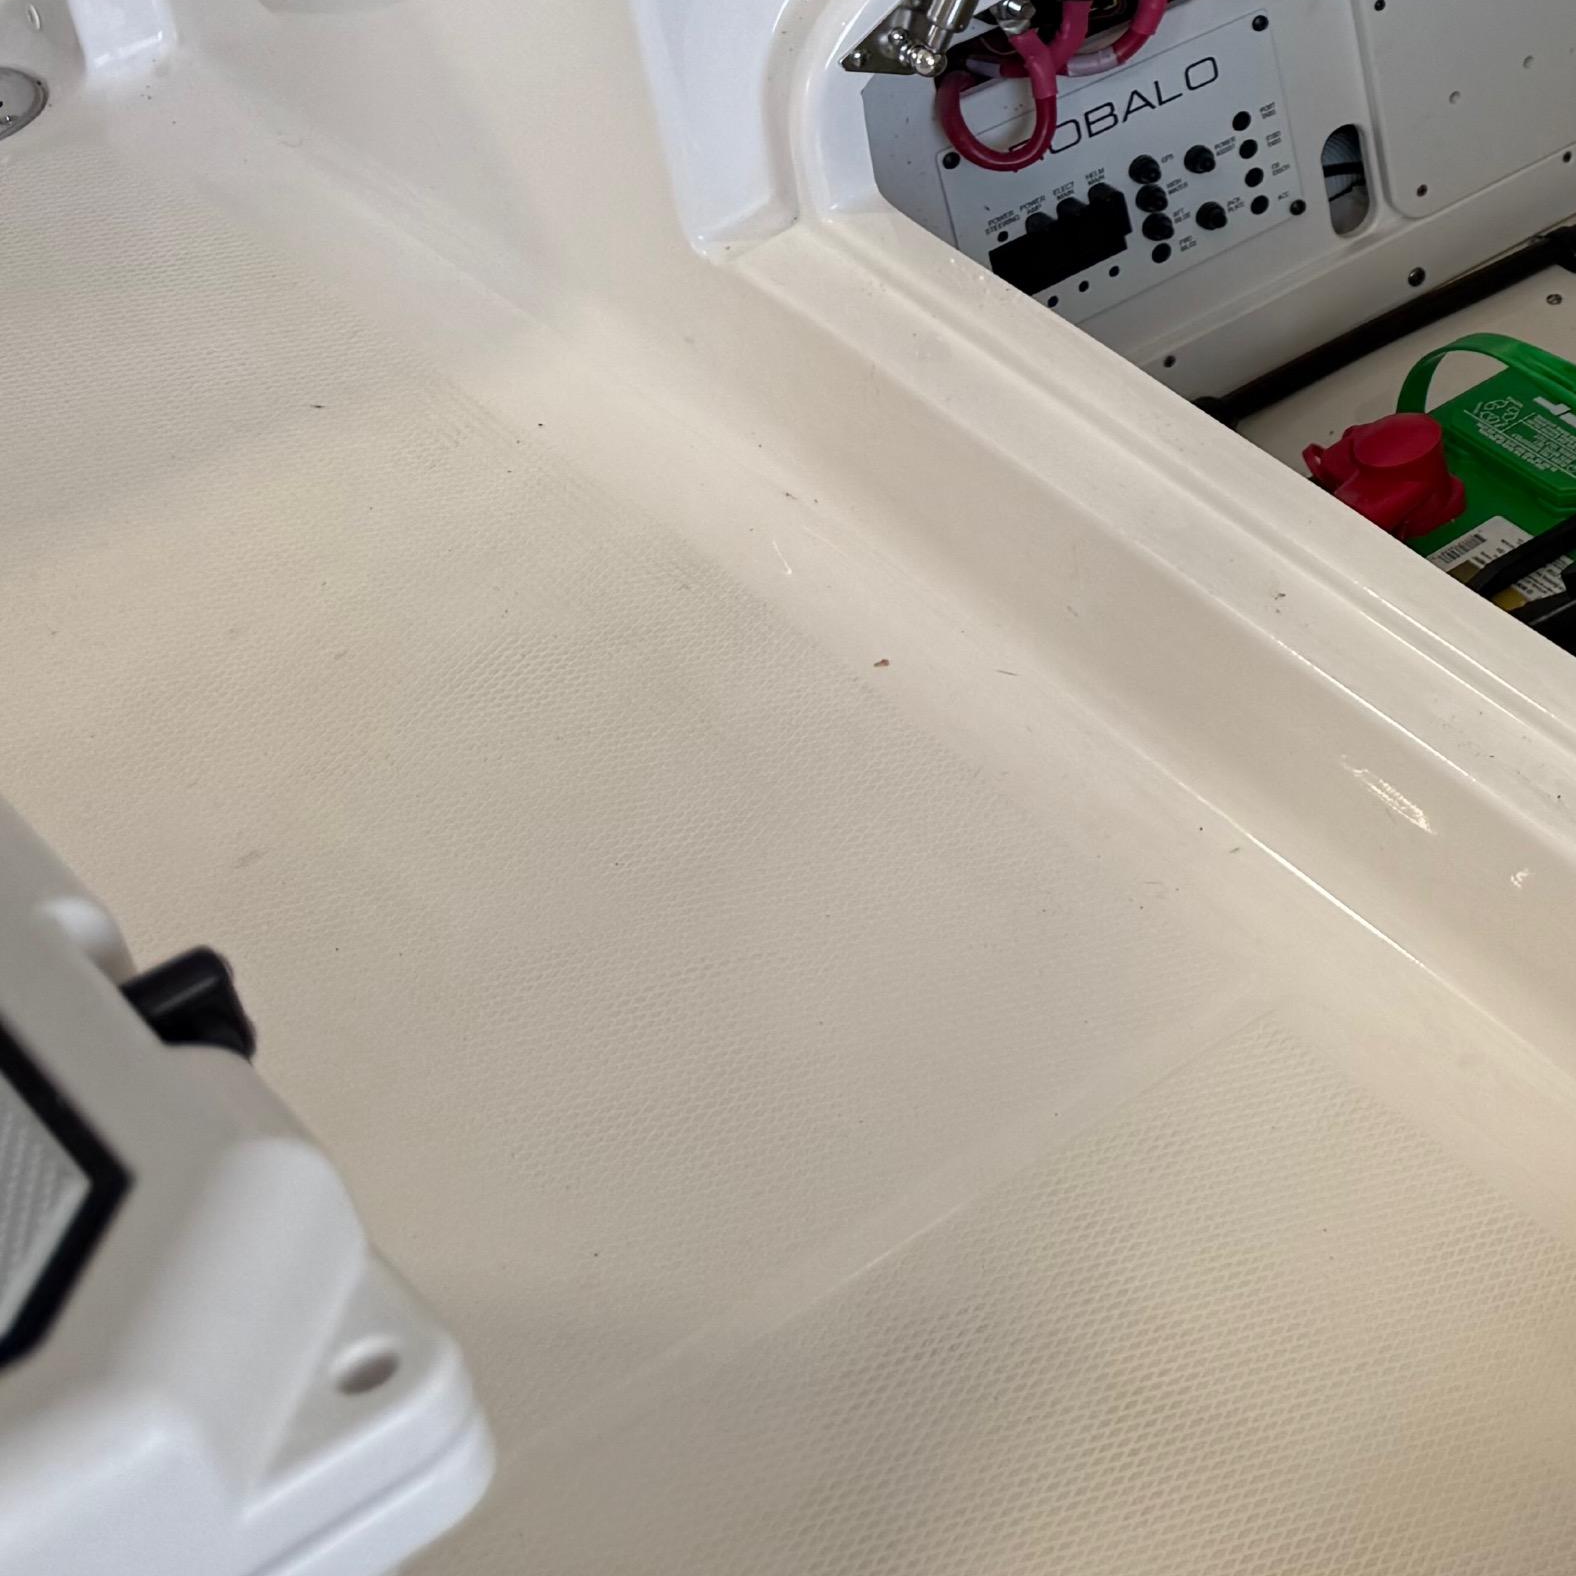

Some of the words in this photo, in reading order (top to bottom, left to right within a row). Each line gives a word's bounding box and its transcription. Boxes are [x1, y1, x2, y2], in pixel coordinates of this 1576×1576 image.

[1008, 56, 1219, 157] OBALO
[1085, 168, 1105, 180] HELM
[1053, 181, 1074, 196] ELECT
[1020, 195, 1046, 211] POWER
[985, 214, 1020, 235] STEERING
[988, 210, 1014, 226] POWER
